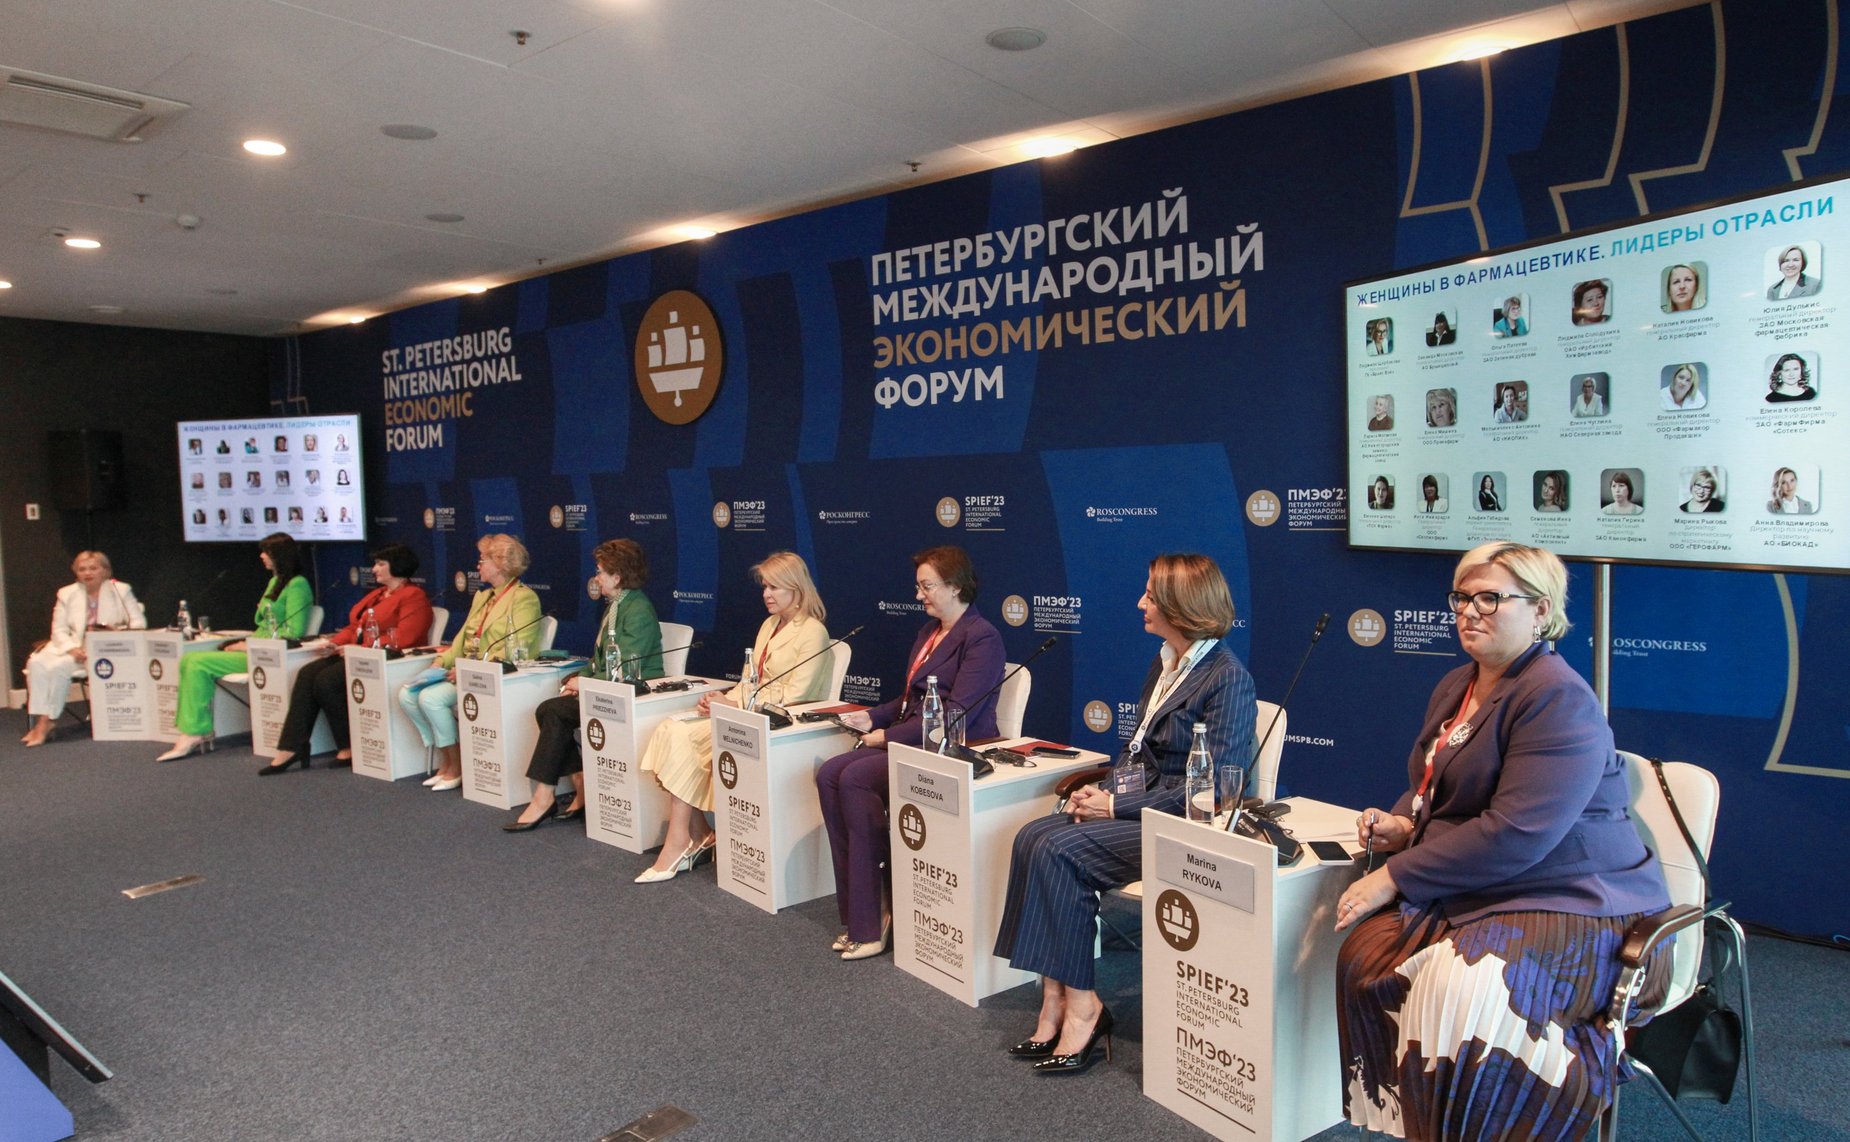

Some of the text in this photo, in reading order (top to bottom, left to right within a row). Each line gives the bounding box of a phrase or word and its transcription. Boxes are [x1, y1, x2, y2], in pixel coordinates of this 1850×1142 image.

[871, 186, 1188, 286] ПЕТЕРБУРГСКИЙ
[1357, 196, 1834, 306] ЖЕНЩИНЫ В ФАРМАЦЕВТИКЕ. ЛИДЕРЫ ОТРАСЛИ
[873, 222, 1264, 325] МЕЖДУНАРОДНЫЙ
[873, 280, 1246, 368] ЭКОНОМИЧЕСКИЙ
[1759, 315, 1824, 328] ЗАО Московская
[382, 326, 512, 374] ST. PETERSBURG
[383, 355, 522, 399] INTERNATIONAL
[874, 365, 1004, 409] ФОРУМ
[385, 391, 473, 426] ECONOMIC
[386, 424, 443, 452] FORUM
[733, 500, 765, 510] ПМЭФ'23
[965, 495, 1005, 506] SPIEF'23
[1096, 507, 1158, 516] ROSCONGRESS
[826, 511, 870, 519] РОСКОНГРЕСС
[1775, 519, 1829, 527] Владимирова
[886, 602, 926, 611] ROSCONGRE
[1033, 595, 1081, 608] ПМЭФ'23
[1394, 609, 1457, 625] SPIEF'23
[1408, 624, 1449, 632] PETERSBURG
[1394, 630, 1452, 639] INTERNATIONAL
[1613, 638, 1707, 652] OSCONGRESS
[843, 674, 881, 687] ПМЭФ'23
[471, 725, 497, 739] SPIEF'23
[596, 755, 627, 773] SPIEF'23
[918, 773, 935, 786] Diana
[598, 792, 632, 812] ПМЭФ'23
[910, 785, 944, 802] KOBESOVA
[729, 795, 761, 818] SPIEF'23
[730, 837, 765, 864] ПМЭФ'23
[912, 858, 958, 888] SPIEF'23
[1186, 853, 1217, 872] Marina
[920, 876, 952, 896] PETERSBURG
[1182, 868, 1222, 892] RYKOVA
[913, 881, 954, 904] INTERNATIONAL
[913, 889, 941, 906] ECONOMIC
[913, 896, 932, 909] FORUM
[914, 909, 963, 945] ПМЭФ'23
[914, 925, 956, 950] ПЕТЕРБУРГСКИЙ
[914, 933, 963, 961] МЕЖДУНАРОДНЫЙ
[915, 940, 963, 969] ЭКОНОМИЧЕСКИЙ
[915, 948, 934, 962] ФОРУМ
[1177, 960, 1249, 1008] SPIEF'23
[1176, 980, 1240, 1016] ST. PETERSBURG
[1177, 990, 1243, 1028] INTERNATIONAL
[1176, 1010, 1205, 1030] FORUM
[1177, 1000, 1220, 1028] ECONOMIC
[1177, 1027, 1256, 1082] ПМЭФ'23
[1177, 1047, 1244, 1089] ПЕТЕРБУРГСКИЙ
[1176, 1057, 1256, 1106] МЕЖДУНАРОДНЫЙ
[1176, 1067, 1254, 1115] ЭКОНОМИЧЕСКИЙ
[1177, 1077, 1206, 1099] ФОРУМ
